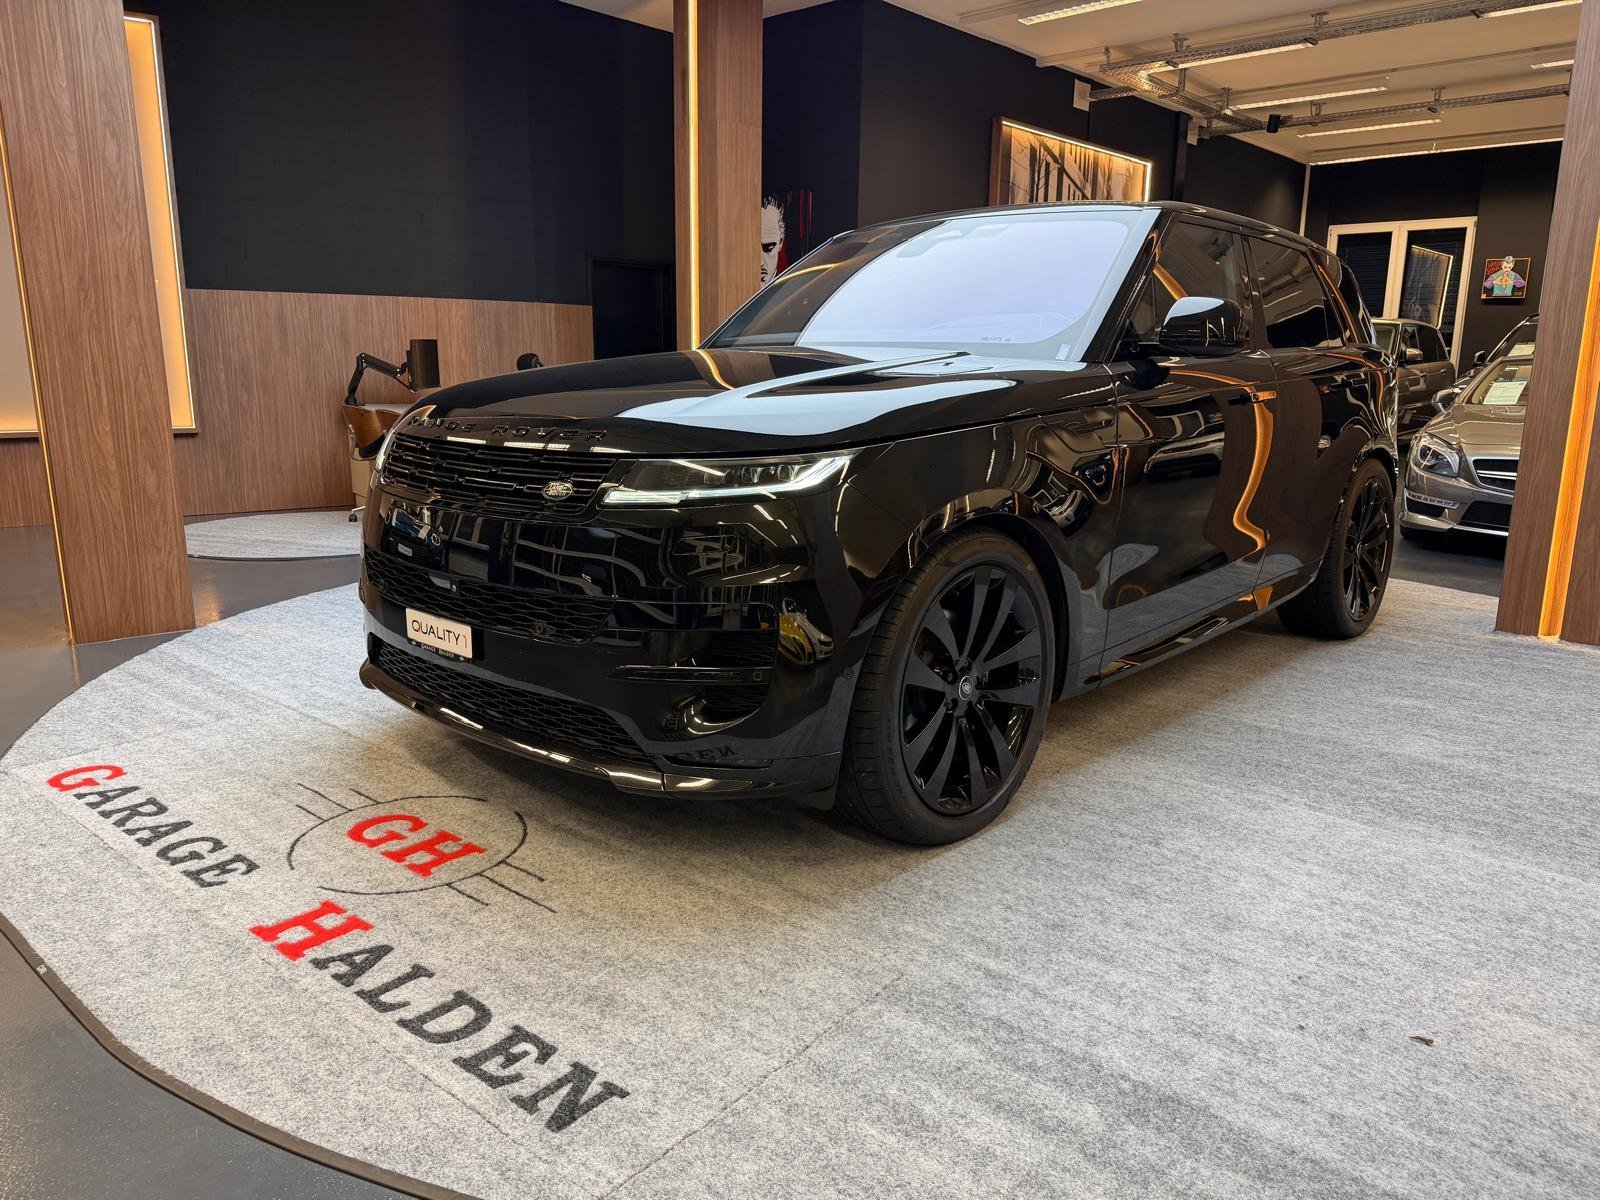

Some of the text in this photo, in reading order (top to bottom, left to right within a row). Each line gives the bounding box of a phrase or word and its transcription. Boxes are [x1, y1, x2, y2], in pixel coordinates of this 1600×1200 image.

[407, 416, 607, 442] RANGE ROVER
[411, 619, 461, 646] QUALITY
[47, 765, 259, 887] GARAGE
[347, 813, 487, 878] GH
[249, 900, 631, 1132] HALDEN
